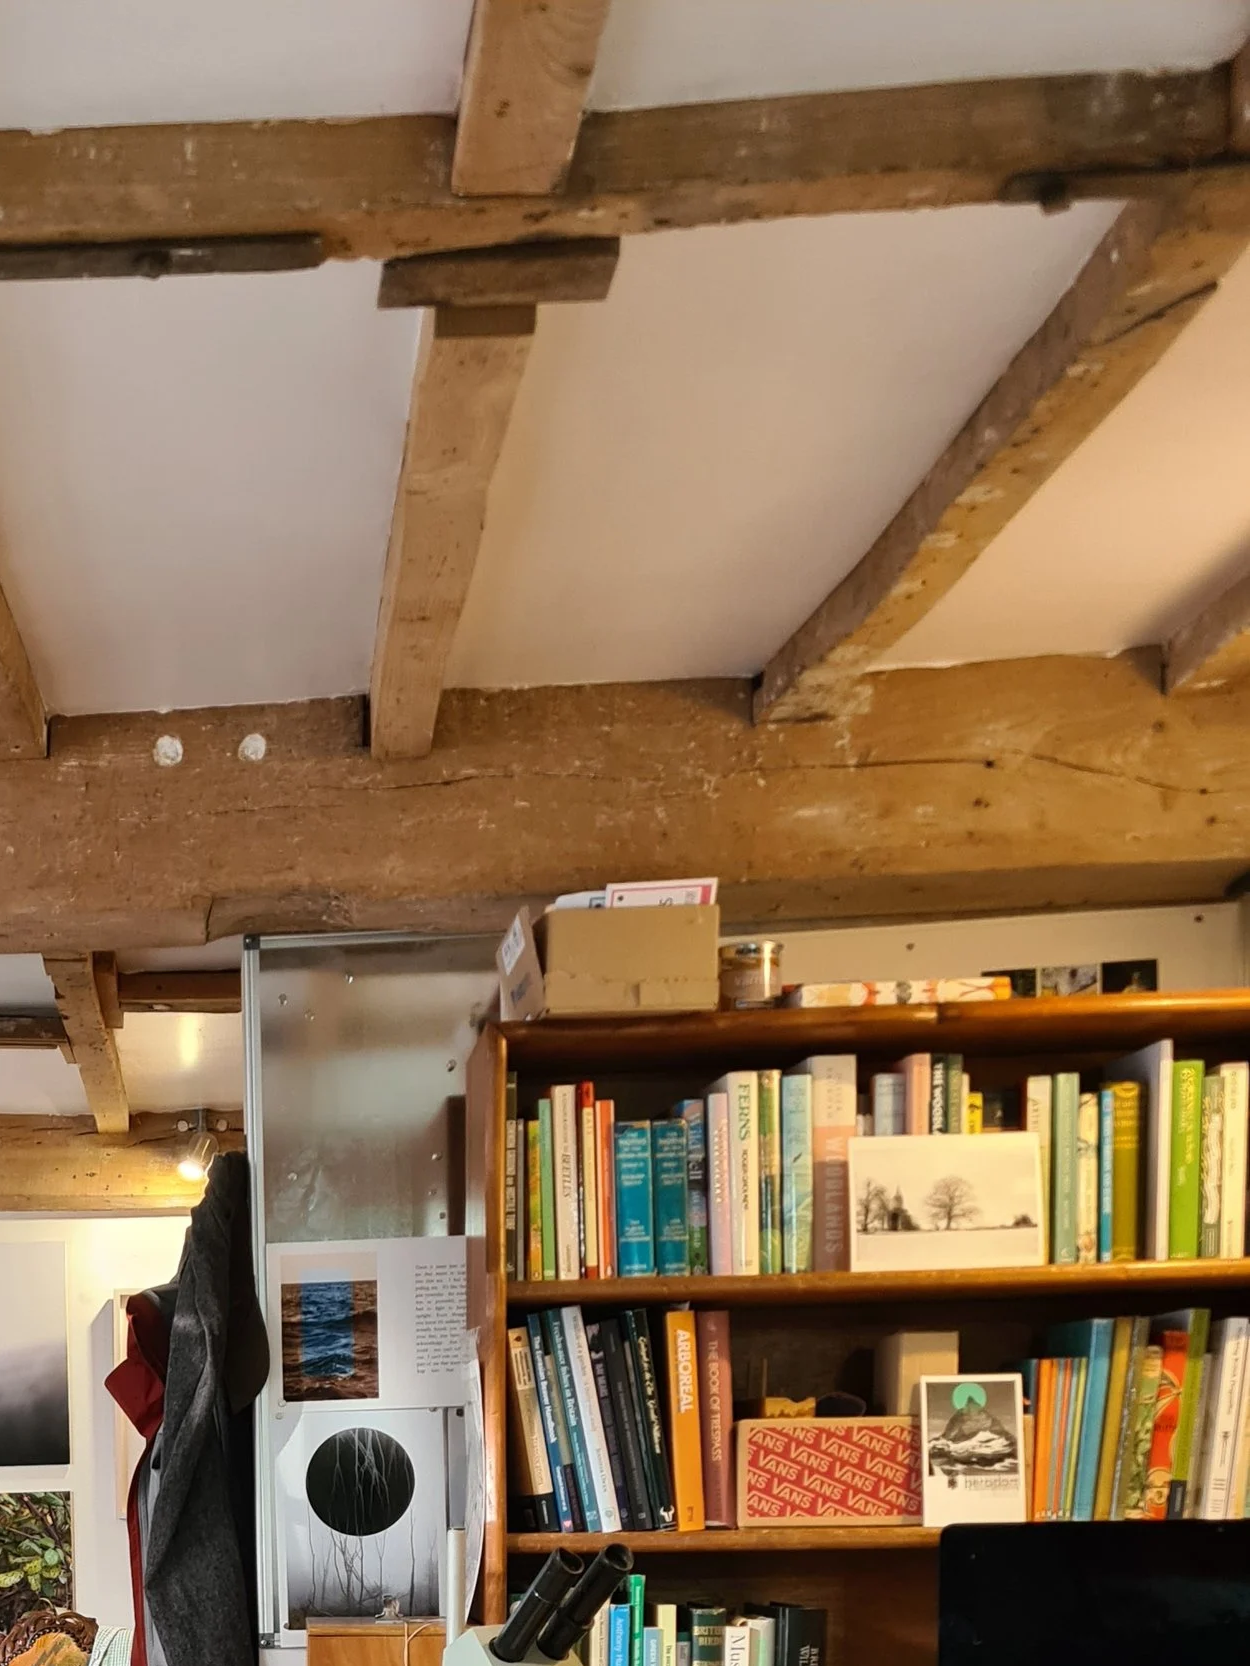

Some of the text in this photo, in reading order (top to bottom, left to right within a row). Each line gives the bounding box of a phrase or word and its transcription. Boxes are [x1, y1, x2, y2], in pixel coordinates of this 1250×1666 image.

[933, 1063, 944, 1085] THE
[738, 1084, 751, 1142] FERNS
[561, 1153, 572, 1199] BEETLES
[551, 1321, 567, 1364] Freshwater
[533, 1335, 557, 1444] The Eurasian Beaver Handbook
[560, 1366, 572, 1389] fishes
[676, 1329, 694, 1414] ARBOREAL
[565, 1398, 578, 1427] Britain
[707, 1340, 722, 1461] THE BOOK OF TRESPASS
[749, 1427, 788, 1453] ANS
[789, 1441, 834, 1473] VANS
[834, 1462, 877, 1492] VANS
[819, 1434, 909, 1483] VANS VANS
[852, 1427, 895, 1456] VANS
[757, 1450, 802, 1481] VANS
[802, 1471, 846, 1501] VANS
[771, 1479, 816, 1510] VANS
[615, 1617, 624, 1651] Anthony
